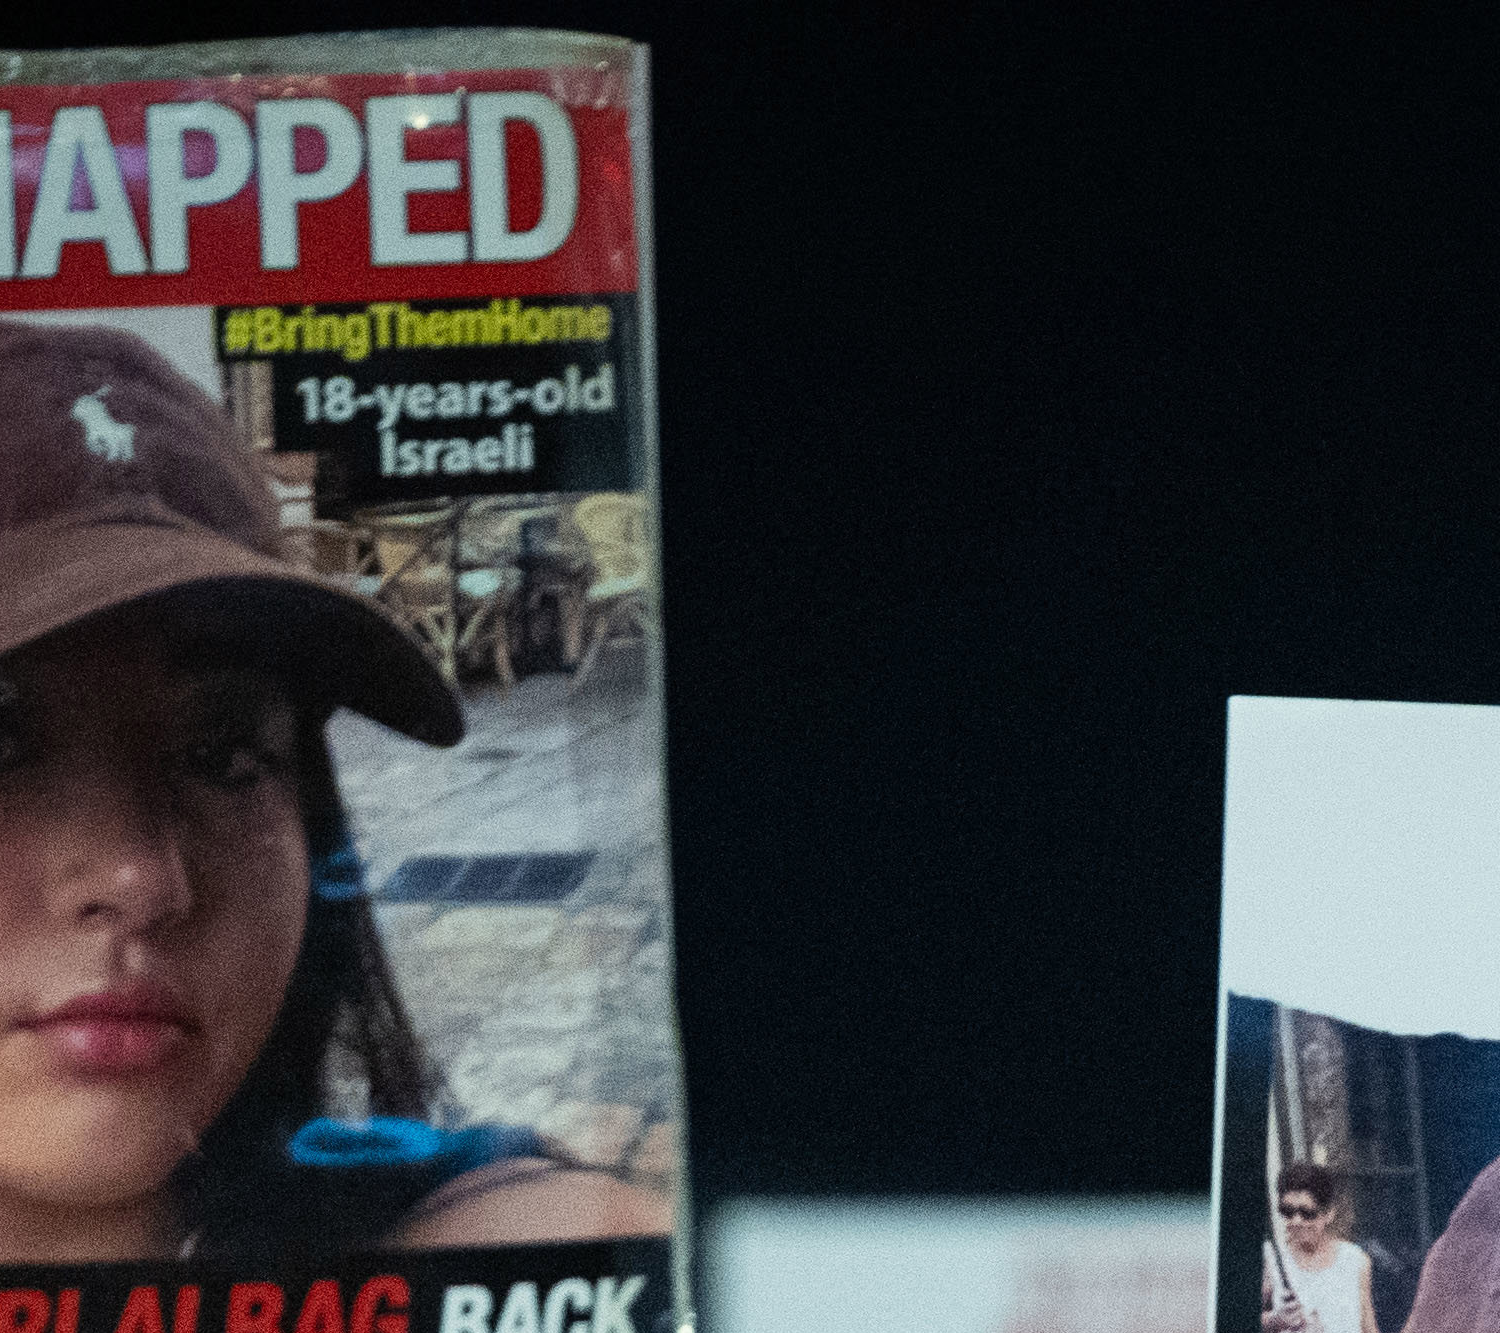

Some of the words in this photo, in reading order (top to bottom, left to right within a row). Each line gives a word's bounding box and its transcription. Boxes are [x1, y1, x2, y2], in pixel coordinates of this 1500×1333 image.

[224, 298, 613, 362] #BringThemHome
[296, 363, 615, 431] 18-years-old
[380, 422, 535, 477] Israeli
